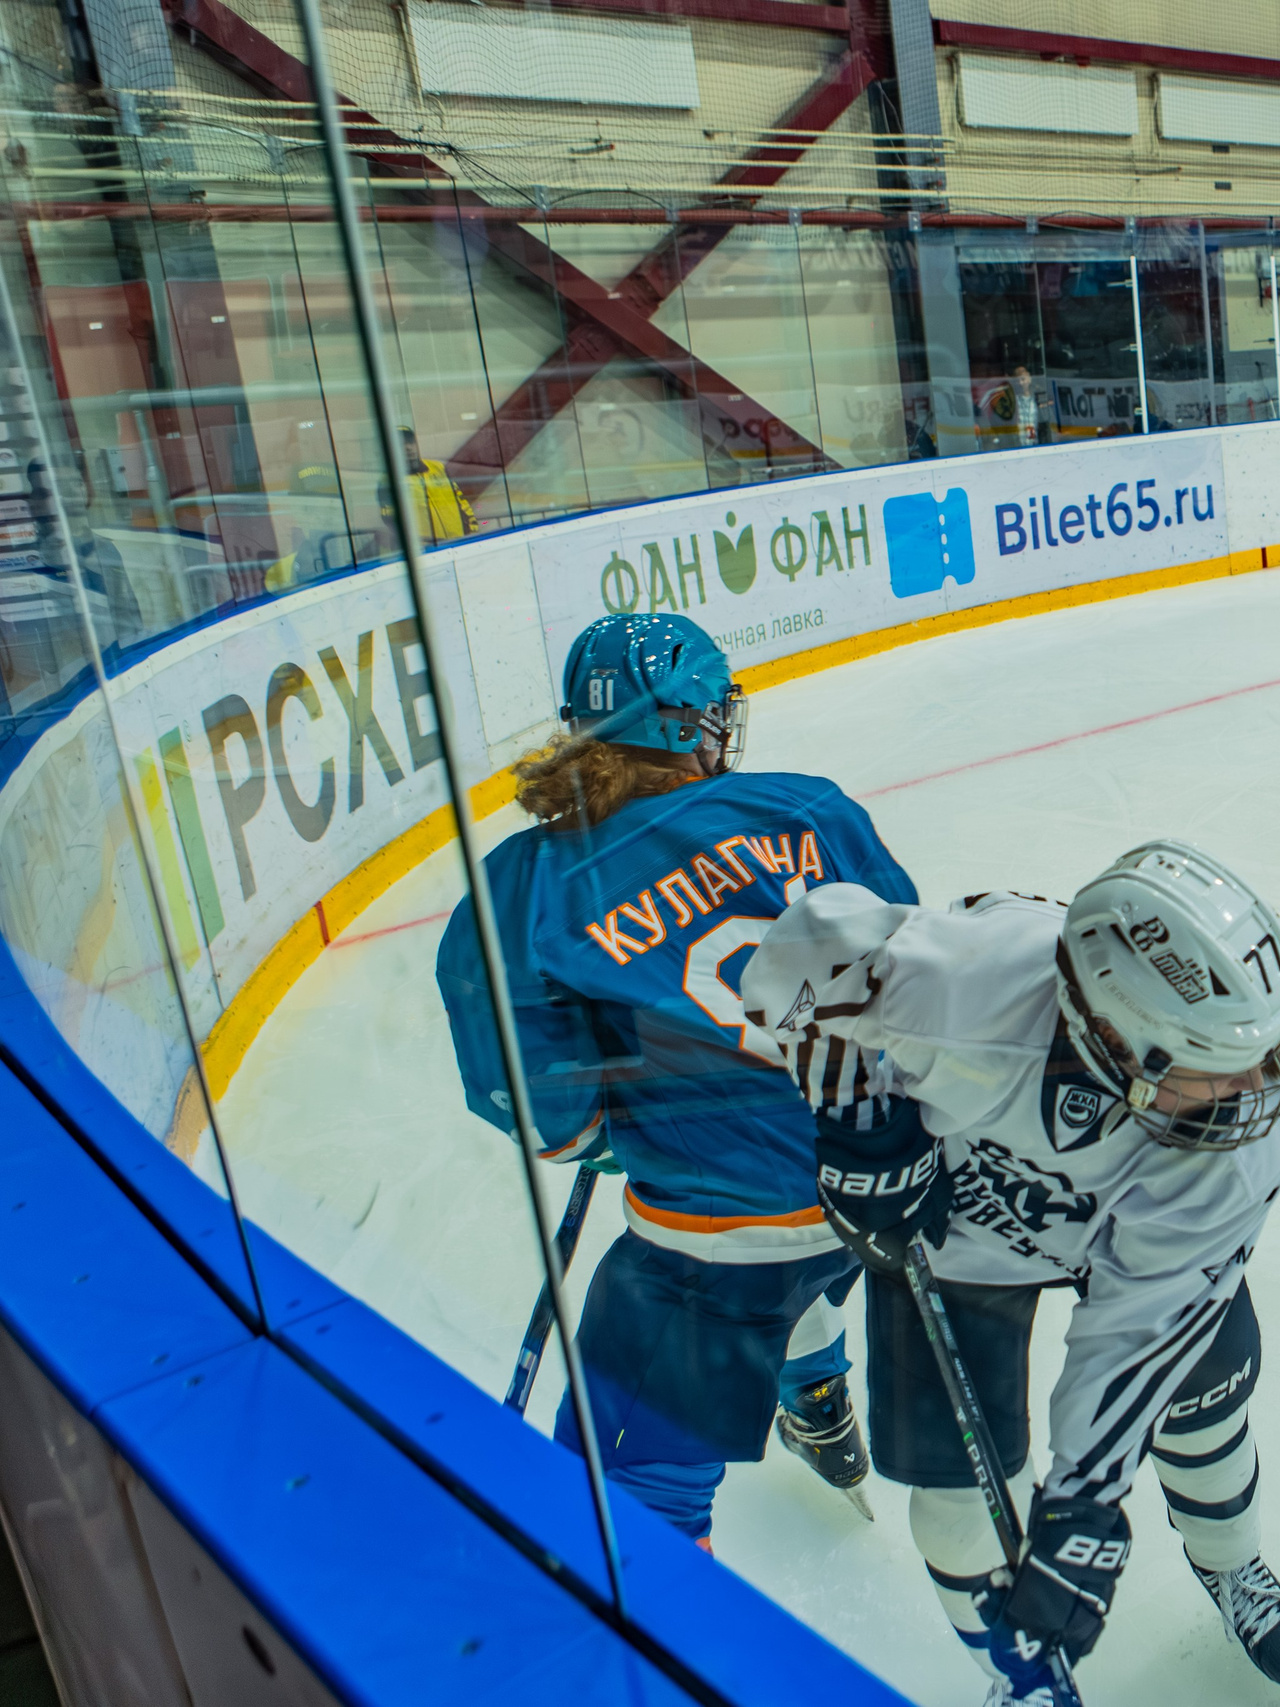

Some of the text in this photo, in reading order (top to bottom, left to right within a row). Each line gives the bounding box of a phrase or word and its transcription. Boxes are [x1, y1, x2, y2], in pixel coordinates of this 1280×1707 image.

[995, 478, 1215, 556] Bilet65.ru
[601, 504, 871, 616] ФАН ФАН
[772, 608, 824, 639] лавка
[589, 679, 614, 711] 81
[1169, 1356, 1252, 1419] CCM
